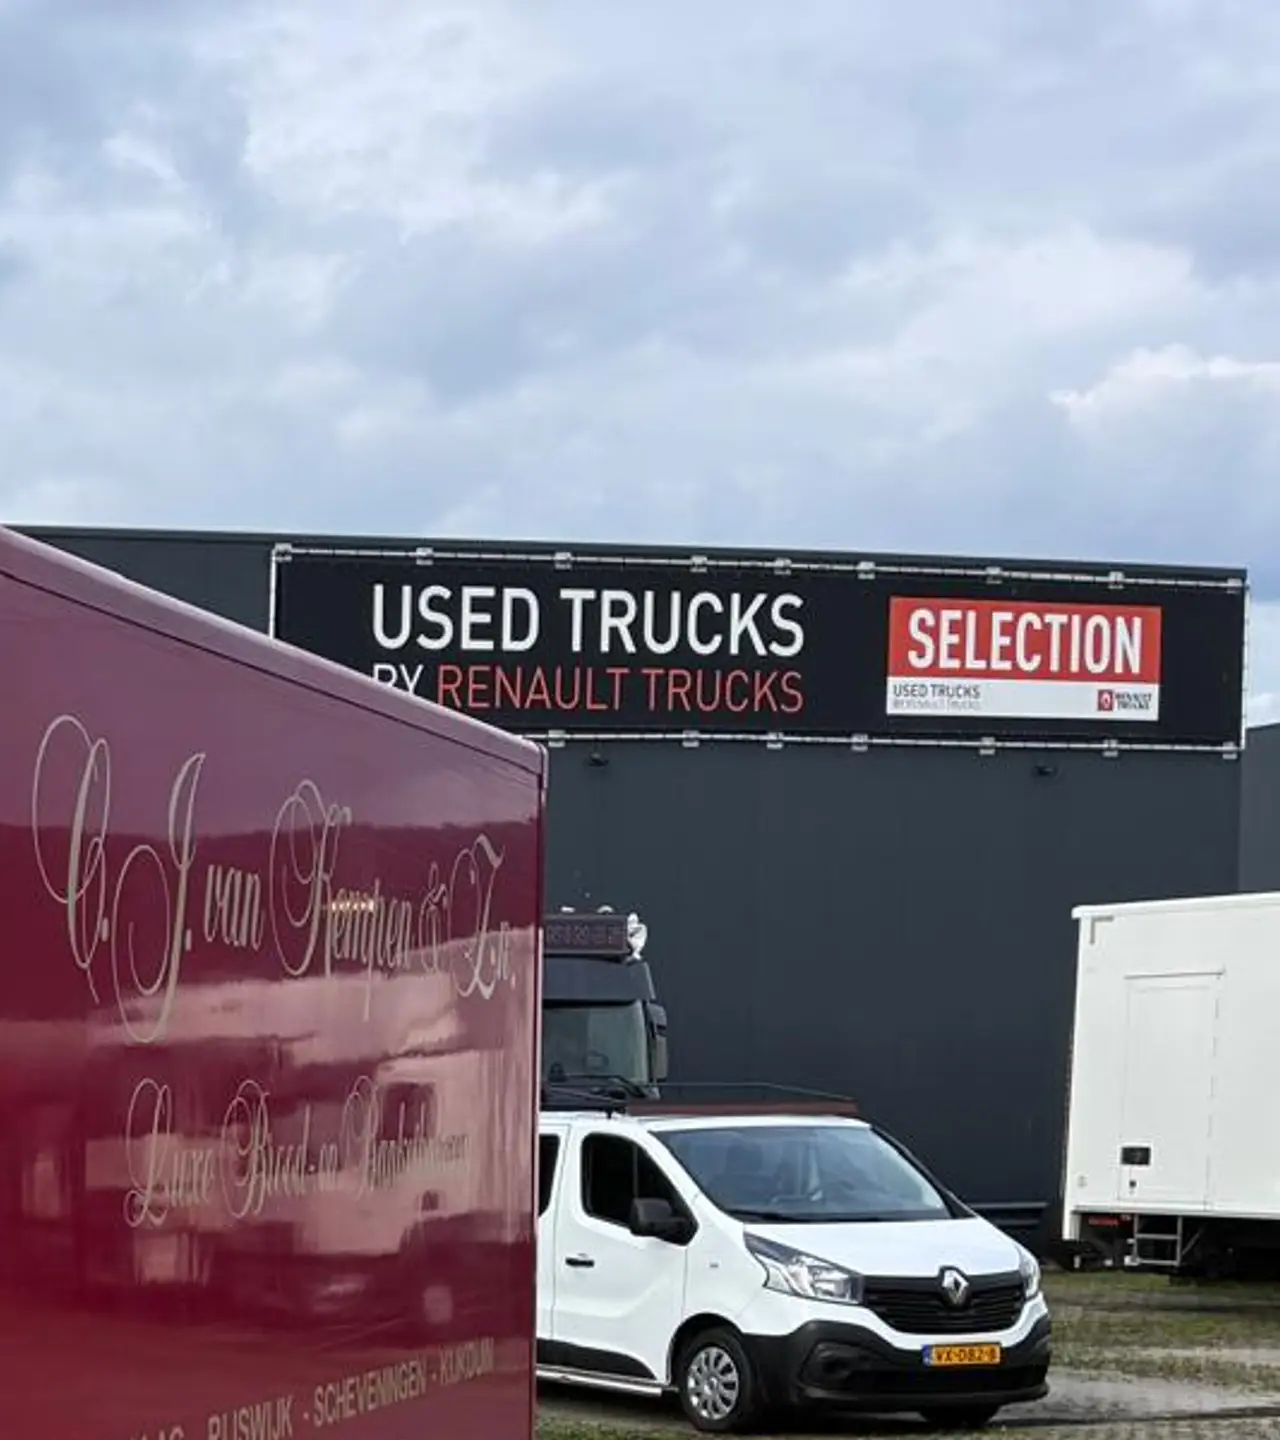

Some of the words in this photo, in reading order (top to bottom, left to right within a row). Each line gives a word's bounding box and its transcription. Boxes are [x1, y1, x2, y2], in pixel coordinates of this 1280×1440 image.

[372, 583, 540, 653] USED
[559, 588, 805, 657] TRUCKS
[907, 608, 1143, 675] SELECTION
[437, 665, 631, 711] RENAULT
[642, 668, 805, 714] TRUCKS
[893, 684, 928, 698] USED
[930, 684, 982, 700] TRUCKS
[203, 863, 265, 951] van
[312, 1359, 428, 1429] SCHEVENINGEN
